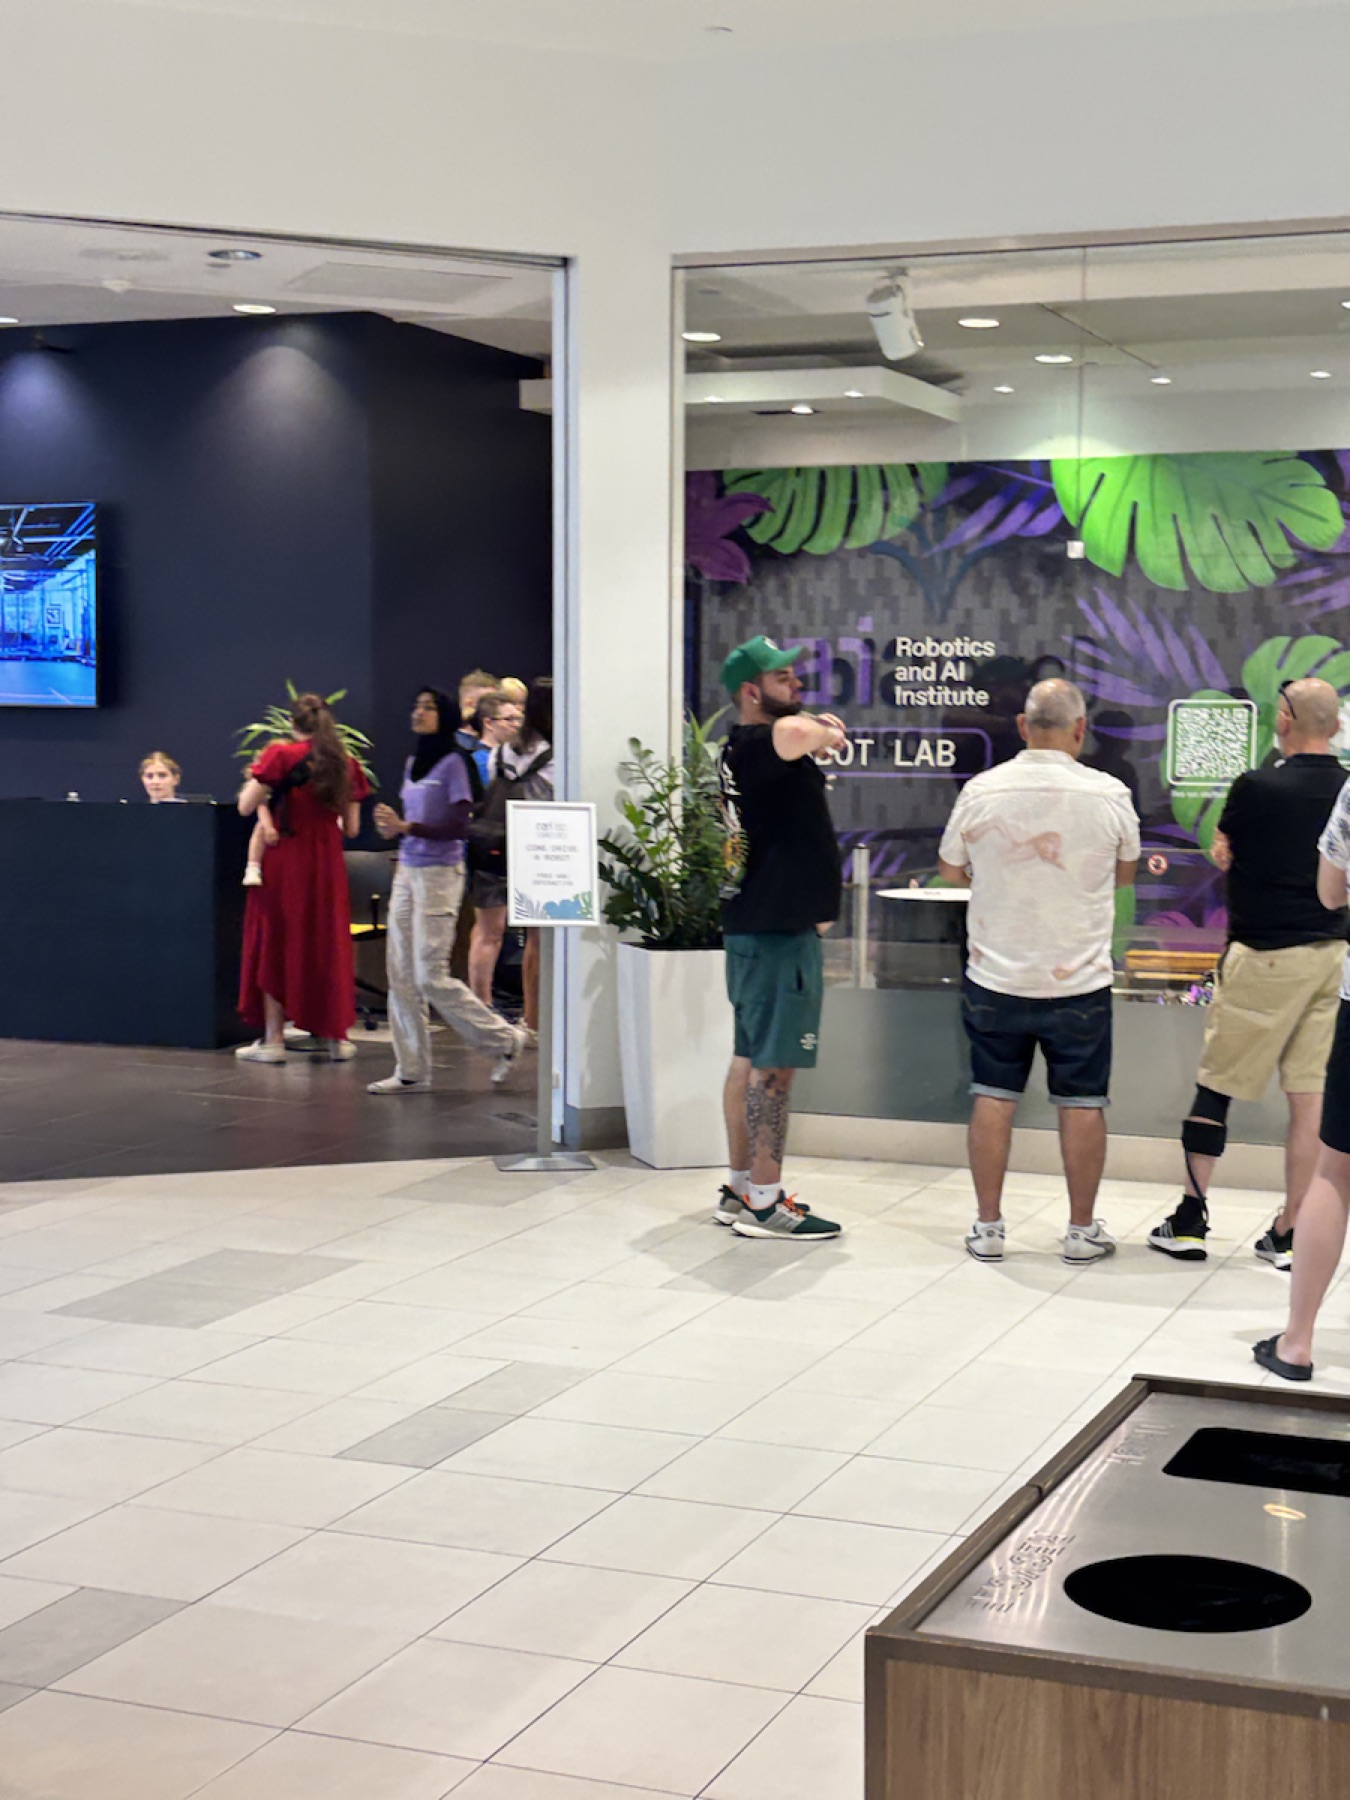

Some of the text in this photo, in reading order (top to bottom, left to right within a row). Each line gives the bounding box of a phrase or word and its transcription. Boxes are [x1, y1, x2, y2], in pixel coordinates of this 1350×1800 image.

[894, 636, 996, 658] Robotics
[894, 661, 966, 682] and AI
[894, 685, 990, 706] Institute
[894, 738, 957, 767] LAB
